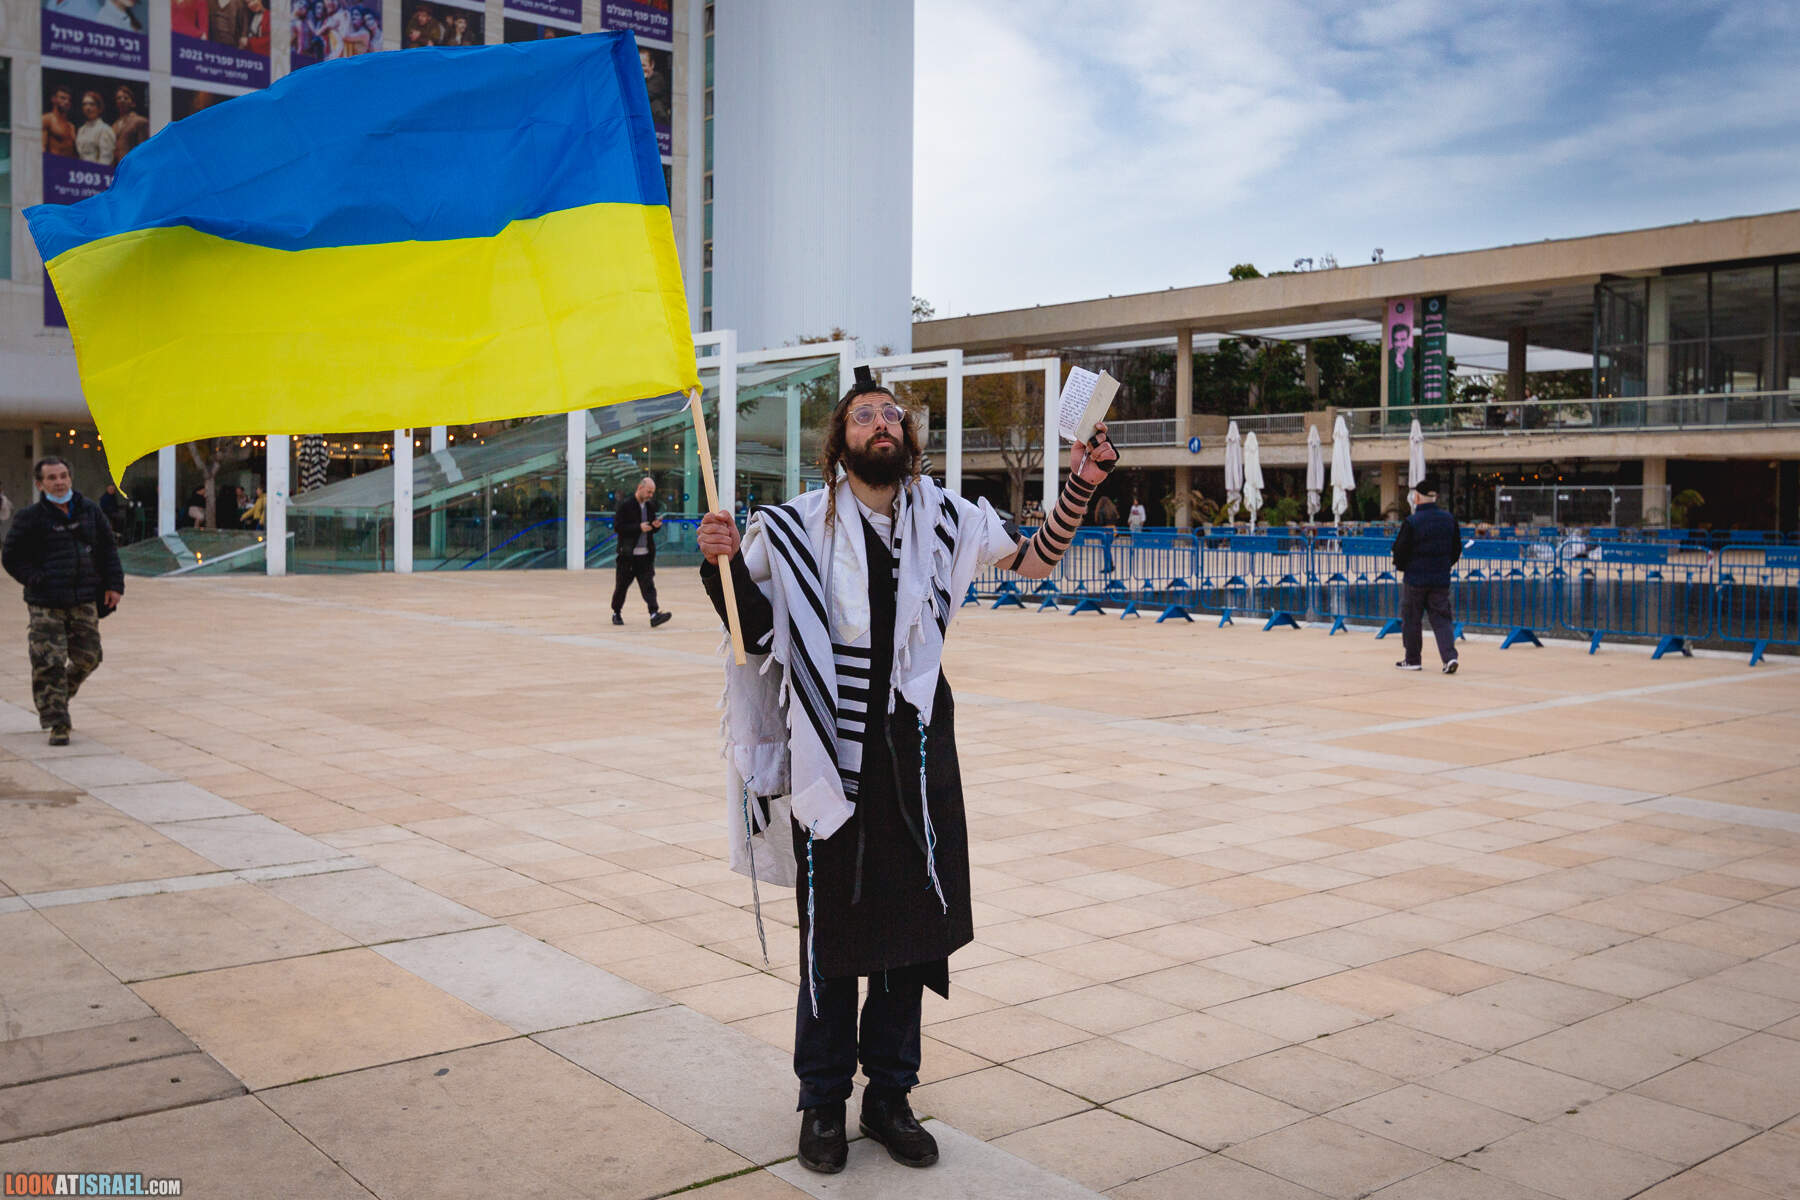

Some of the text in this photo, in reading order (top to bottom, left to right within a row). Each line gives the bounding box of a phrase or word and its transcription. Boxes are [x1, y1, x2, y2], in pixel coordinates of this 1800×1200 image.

[50, 22, 84, 43] טיול
[87, 31, 115, 48] מהו
[204, 52, 234, 66] ספרדי
[69, 170, 101, 186] 1903
